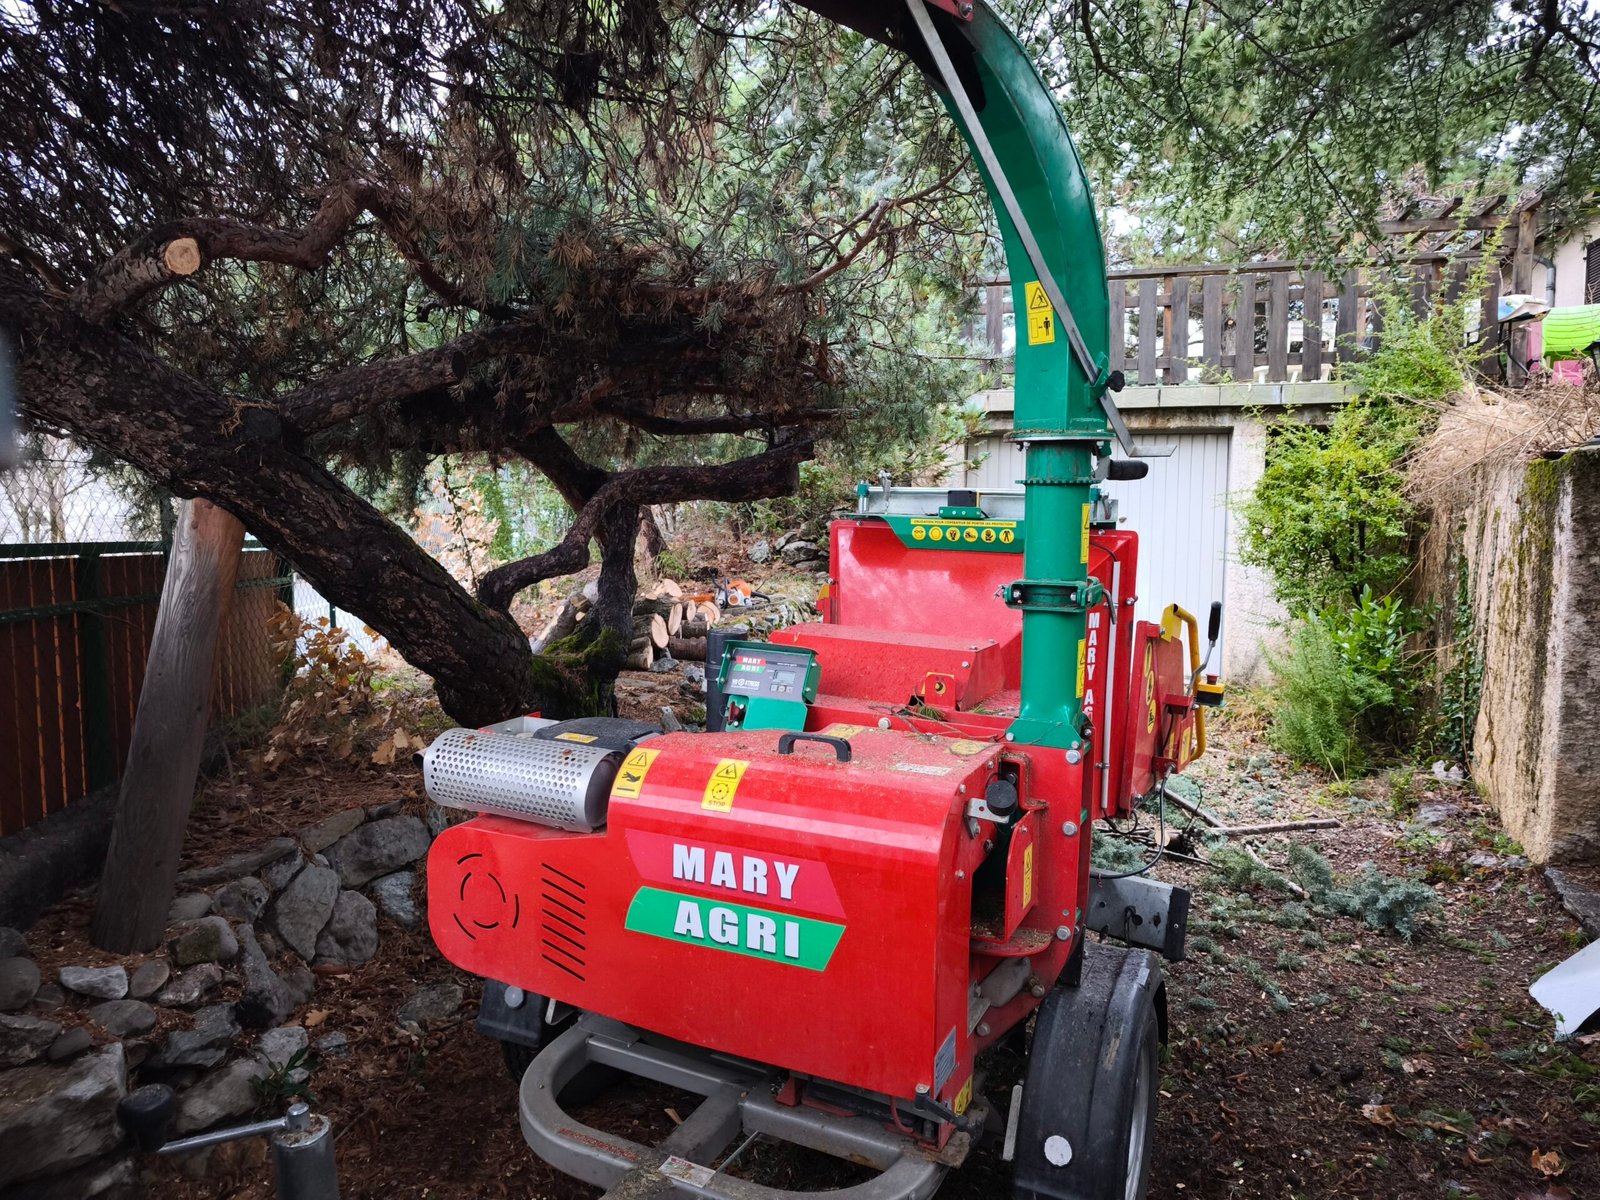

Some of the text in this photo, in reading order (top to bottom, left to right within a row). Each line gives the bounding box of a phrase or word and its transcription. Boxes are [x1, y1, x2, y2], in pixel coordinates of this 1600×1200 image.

[742, 657, 762, 665] MARY
[1087, 612, 1100, 681] MARY
[672, 843, 800, 900] MARY
[673, 900, 800, 959] AGRI
